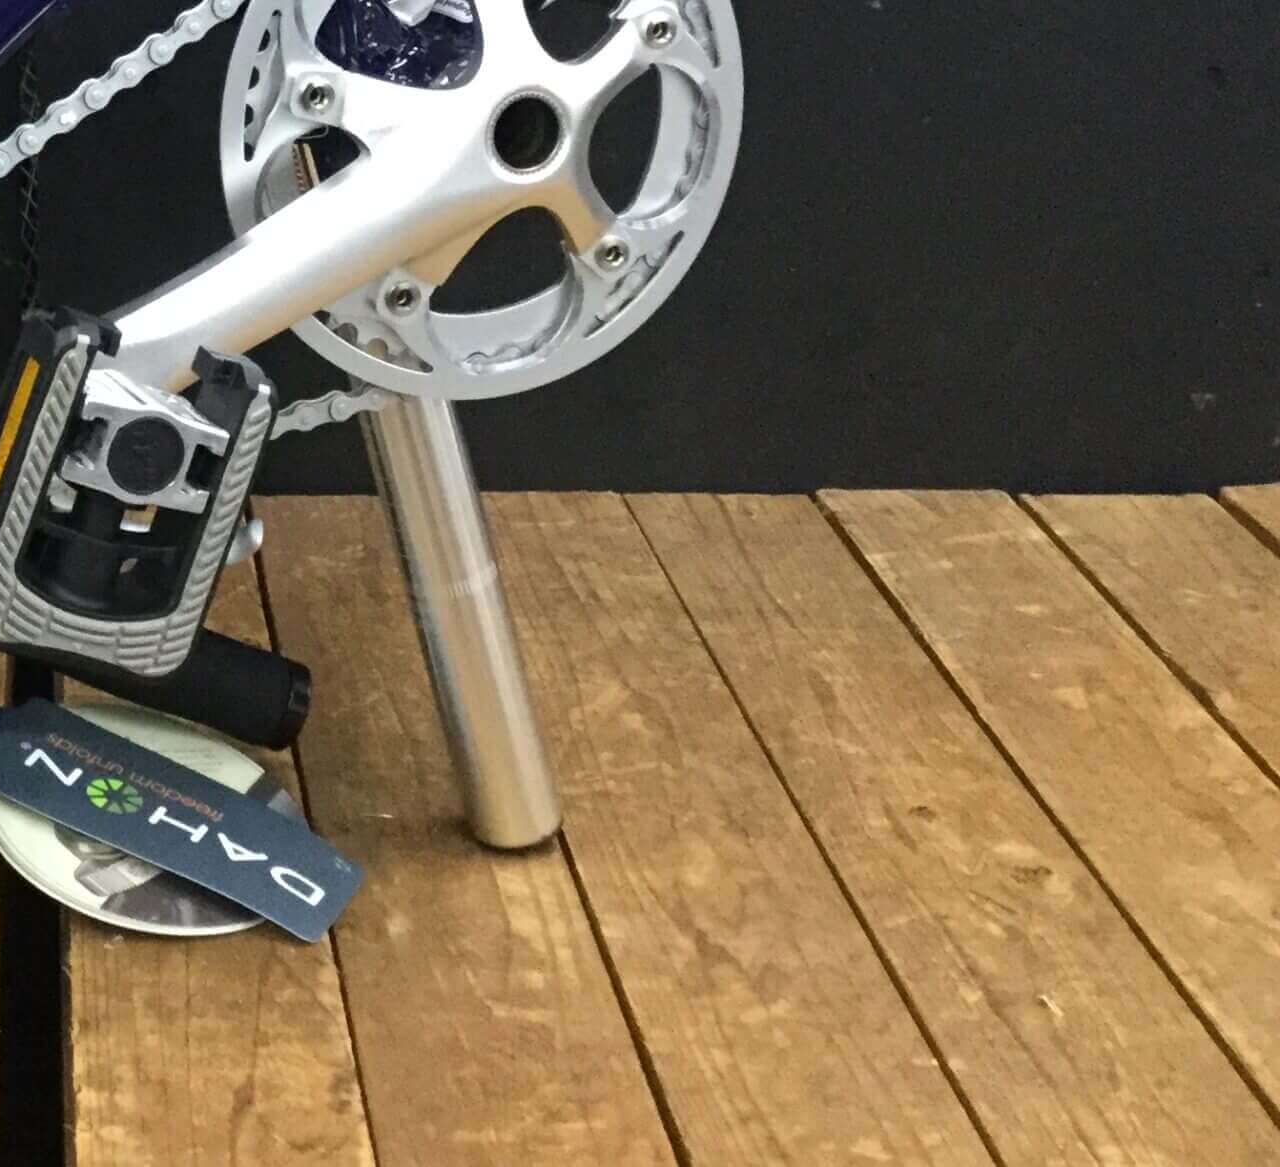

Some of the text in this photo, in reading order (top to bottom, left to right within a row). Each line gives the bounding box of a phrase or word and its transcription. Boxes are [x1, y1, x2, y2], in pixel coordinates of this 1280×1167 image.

[46, 732, 125, 777] unfolds
[130, 771, 224, 823] freedom
[23, 747, 326, 907] DAHON
